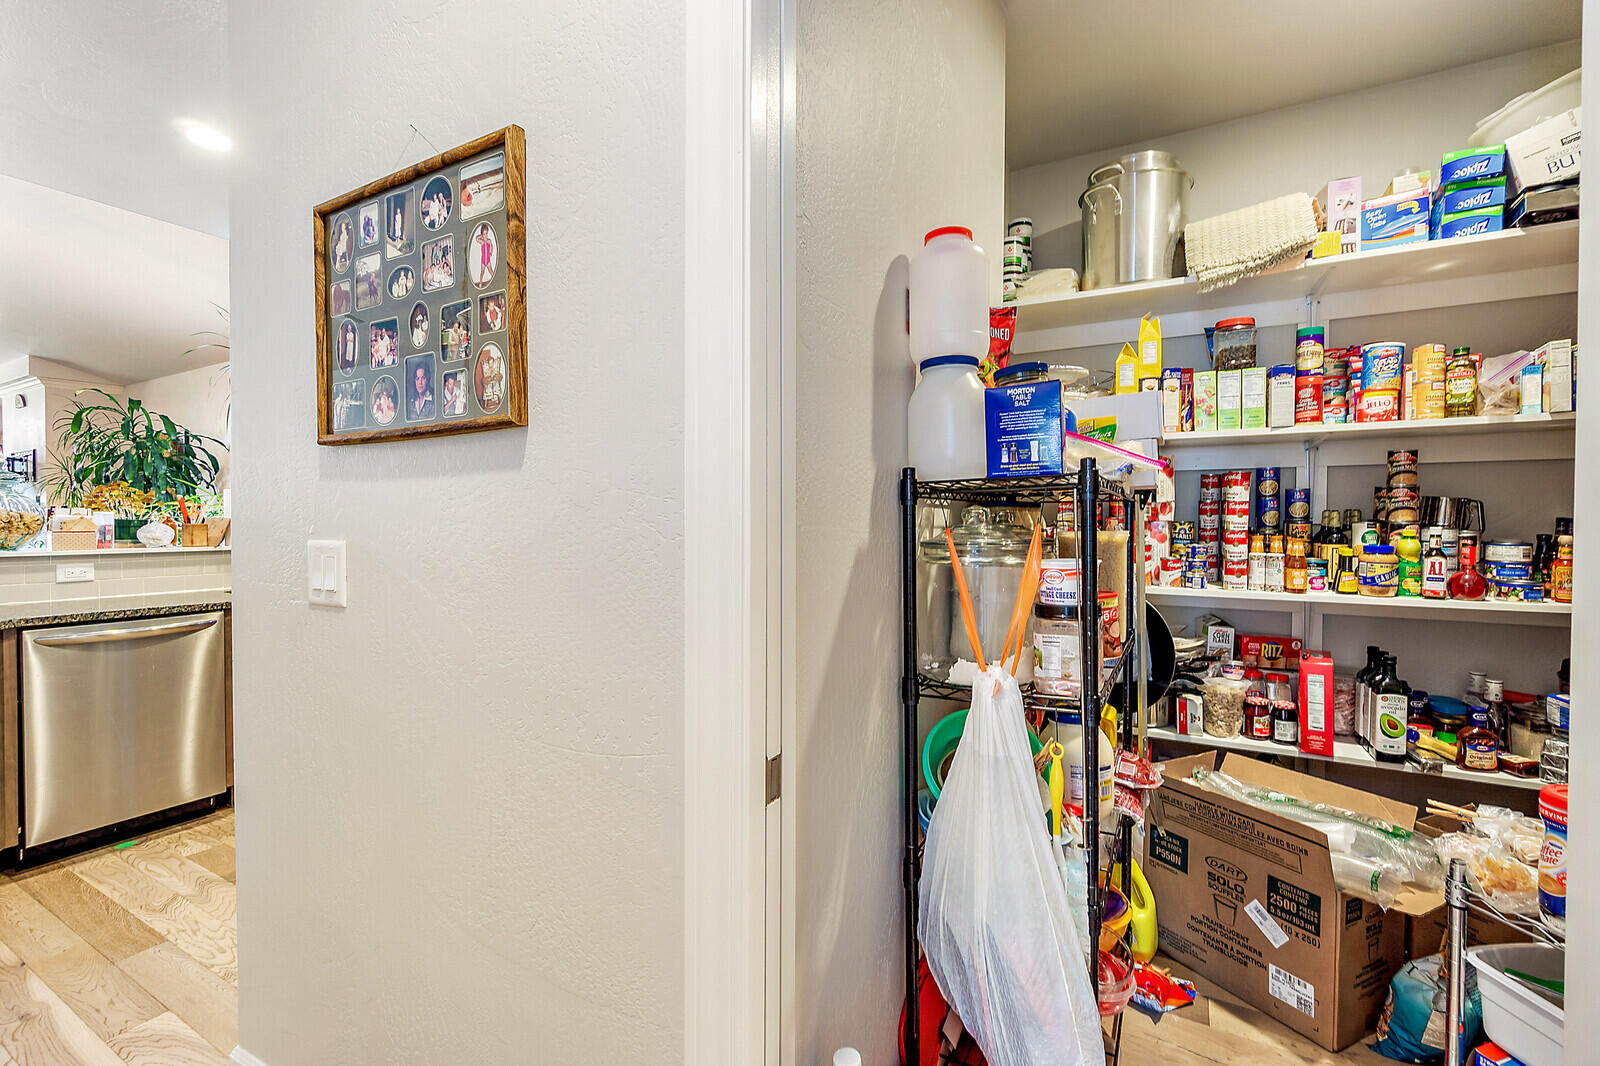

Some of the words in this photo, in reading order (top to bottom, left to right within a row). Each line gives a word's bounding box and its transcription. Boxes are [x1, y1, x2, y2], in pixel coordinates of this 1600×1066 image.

[1453, 158, 1490, 178] Ziploc
[1457, 190, 1492, 210] Ziploc
[1366, 208, 1383, 219] Easy
[1367, 213, 1387, 224] Open
[1454, 218, 1489, 238] Ziploc
[989, 327, 1010, 341] ONED
[1007, 386, 1036, 396] MORTON
[1375, 570, 1398, 584] GARLIC
[1055, 591, 1077, 600] CHEESE
[1212, 631, 1230, 639] CORN
[1261, 643, 1284, 658] RITZ
[1469, 753, 1494, 762] Original
[1237, 816, 1256, 829] CARE
[1266, 832, 1284, 847] AVEC
[1286, 840, 1309, 857] SOINS
[1543, 845, 1563, 858] ffee
[1156, 846, 1182, 866] P550N
[1210, 859, 1242, 878] DART
[1208, 871, 1245, 895] SOLO
[1278, 881, 1310, 900] CONTENTS
[1270, 892, 1297, 914] 2500
[1279, 888, 1308, 906] CONTENU
[1190, 915, 1219, 934] PORTION
[1219, 931, 1263, 958] CONTAINERS
[1202, 914, 1249, 943] TRANSLUCENT
[1281, 922, 1293, 935] (10
[1301, 932, 1321, 949] 250)
[1186, 922, 1229, 950] CONTENANTS
[1236, 949, 1267, 971] PORTION
[1202, 938, 1249, 968] TRANSLUCIDE
